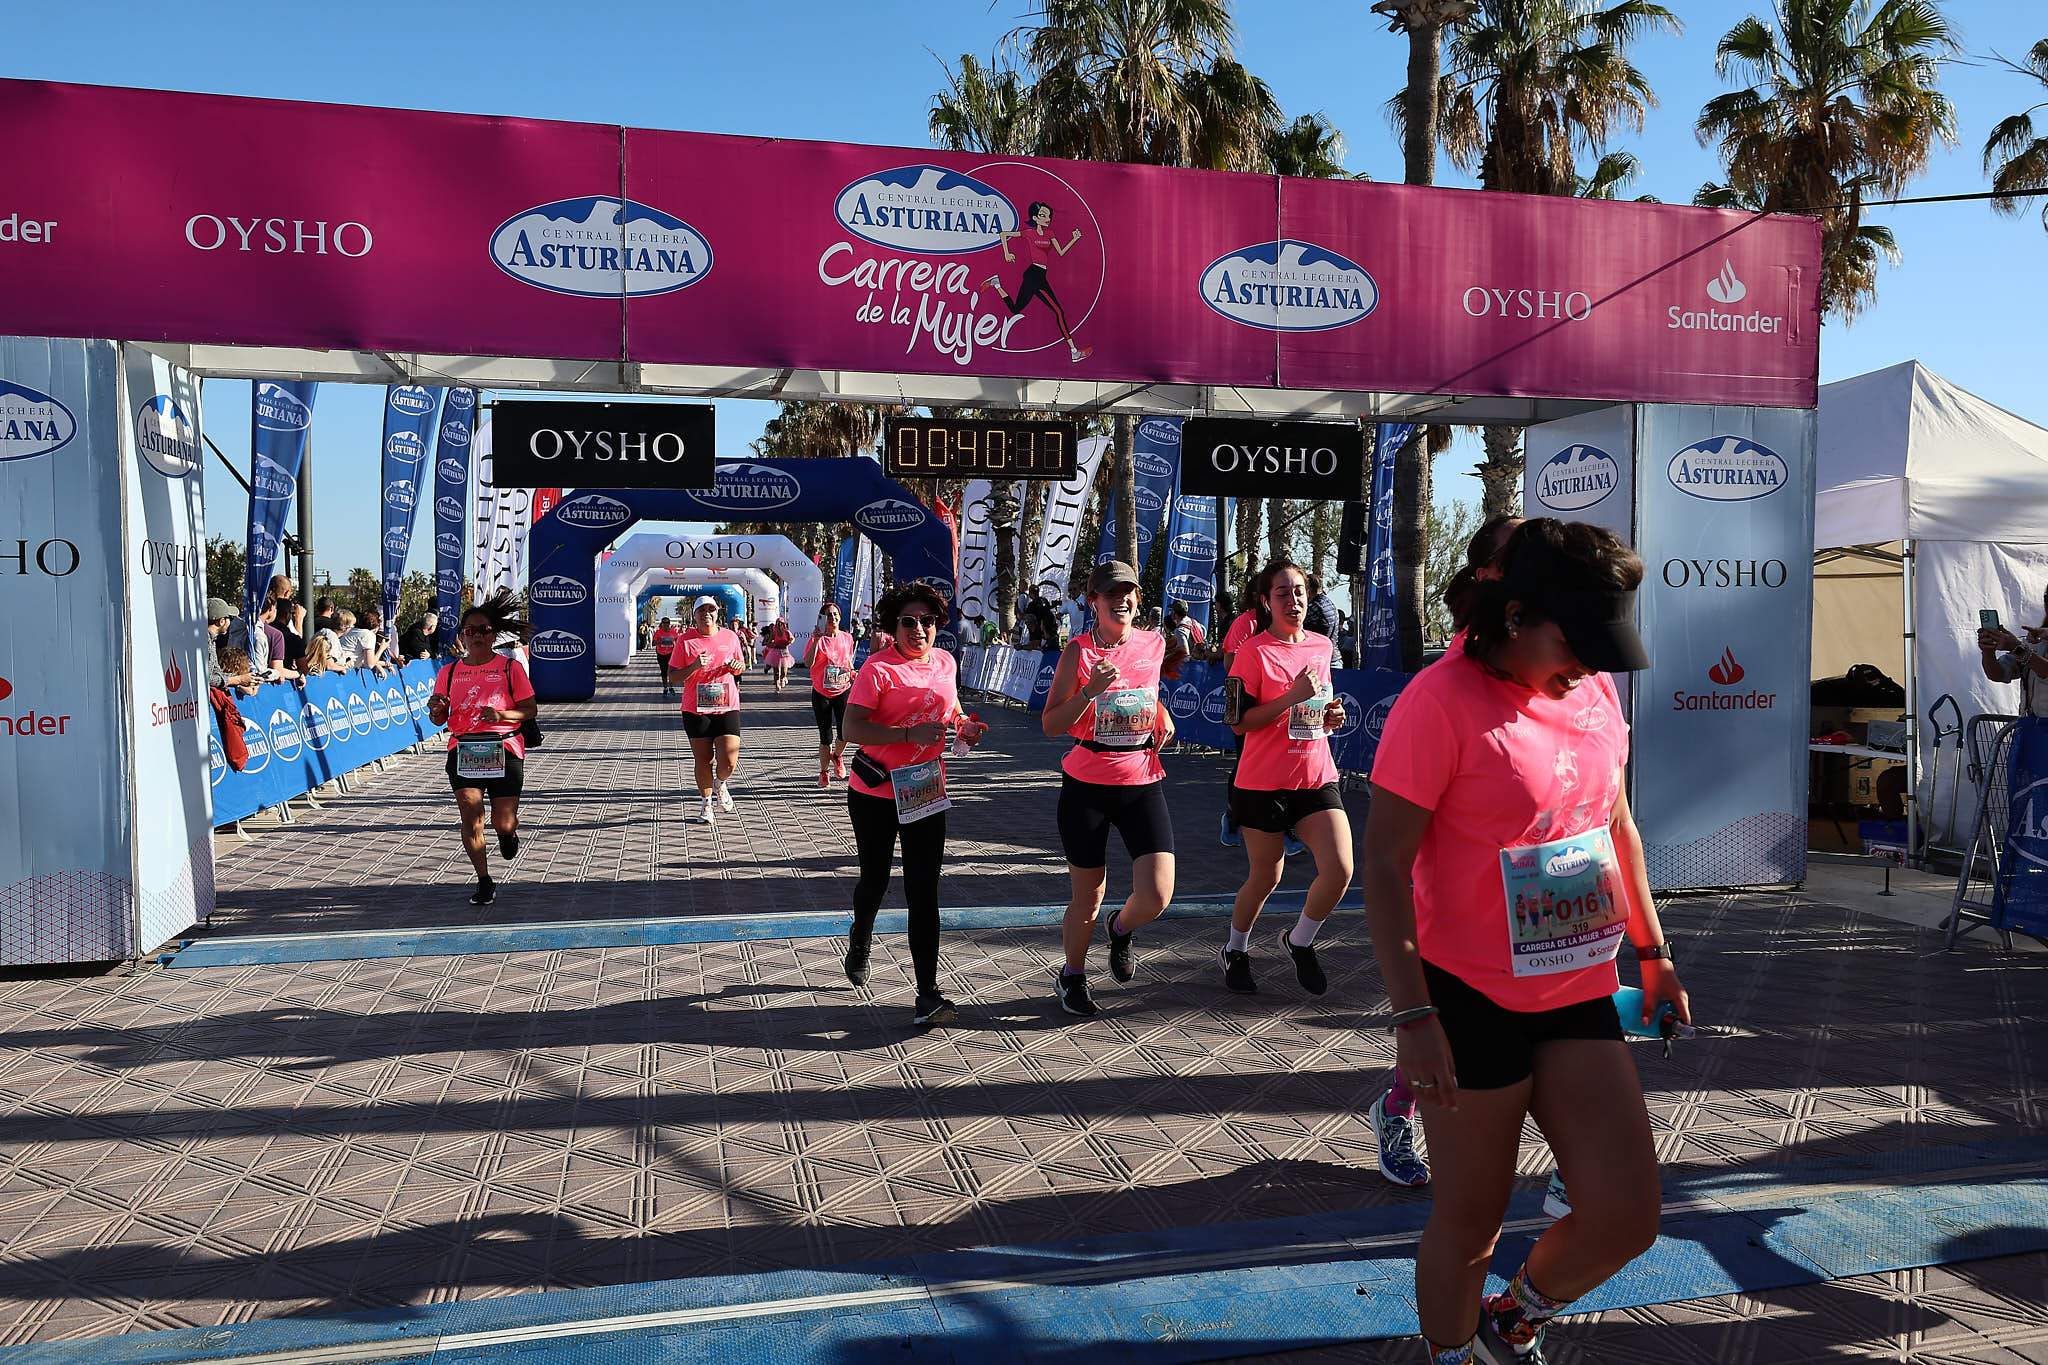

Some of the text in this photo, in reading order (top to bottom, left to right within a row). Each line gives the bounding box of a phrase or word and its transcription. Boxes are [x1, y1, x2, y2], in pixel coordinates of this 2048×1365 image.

[849, 192, 1003, 235] ASTURIANA
[877, 192, 999, 209] CENTRAL LECHERA
[184, 214, 373, 257] OYSHO
[542, 228, 612, 241] CENTRAL
[507, 229, 697, 274] ASTURIANA
[818, 241, 970, 294] Carrera
[1241, 269, 1360, 284] CENTRAL LECHERA
[1213, 270, 1365, 310] ASTURIANA
[1462, 286, 1592, 321] OYSHO
[856, 291, 1025, 365] de la Mujer
[1667, 305, 1782, 334] Santander
[0, 420, 62, 441] ANA
[141, 417, 194, 462] ASTURIANA
[529, 428, 686, 464] OYSHO
[898, 427, 1063, 469] 00:40:17
[1211, 443, 1338, 476] OYSHO
[1675, 458, 1779, 485] ASTURIANA
[1695, 457, 1733, 466] CENTRAL
[1540, 472, 1612, 498] ASTURIANA
[561, 507, 625, 520] ASTURIANA
[861, 511, 921, 524] ASTURIANA
[141, 540, 199, 579] OYSHO
[665, 540, 755, 559] OYSHO
[1662, 558, 1787, 588] OYSHO
[533, 586, 582, 599] ASTURIANA
[532, 640, 582, 653] ASTURIANA
[151, 699, 199, 727] Santander
[1673, 690, 1777, 711] Santander
[1556, 891, 1598, 921] 016
[1520, 940, 1555, 952] CARRERA
[1557, 938, 1567, 947] DE
[1568, 936, 1578, 945] LA
[1579, 931, 1600, 943] MUJER
[1572, 922, 1589, 934] 319
[1529, 953, 1574, 967] OYSHO
